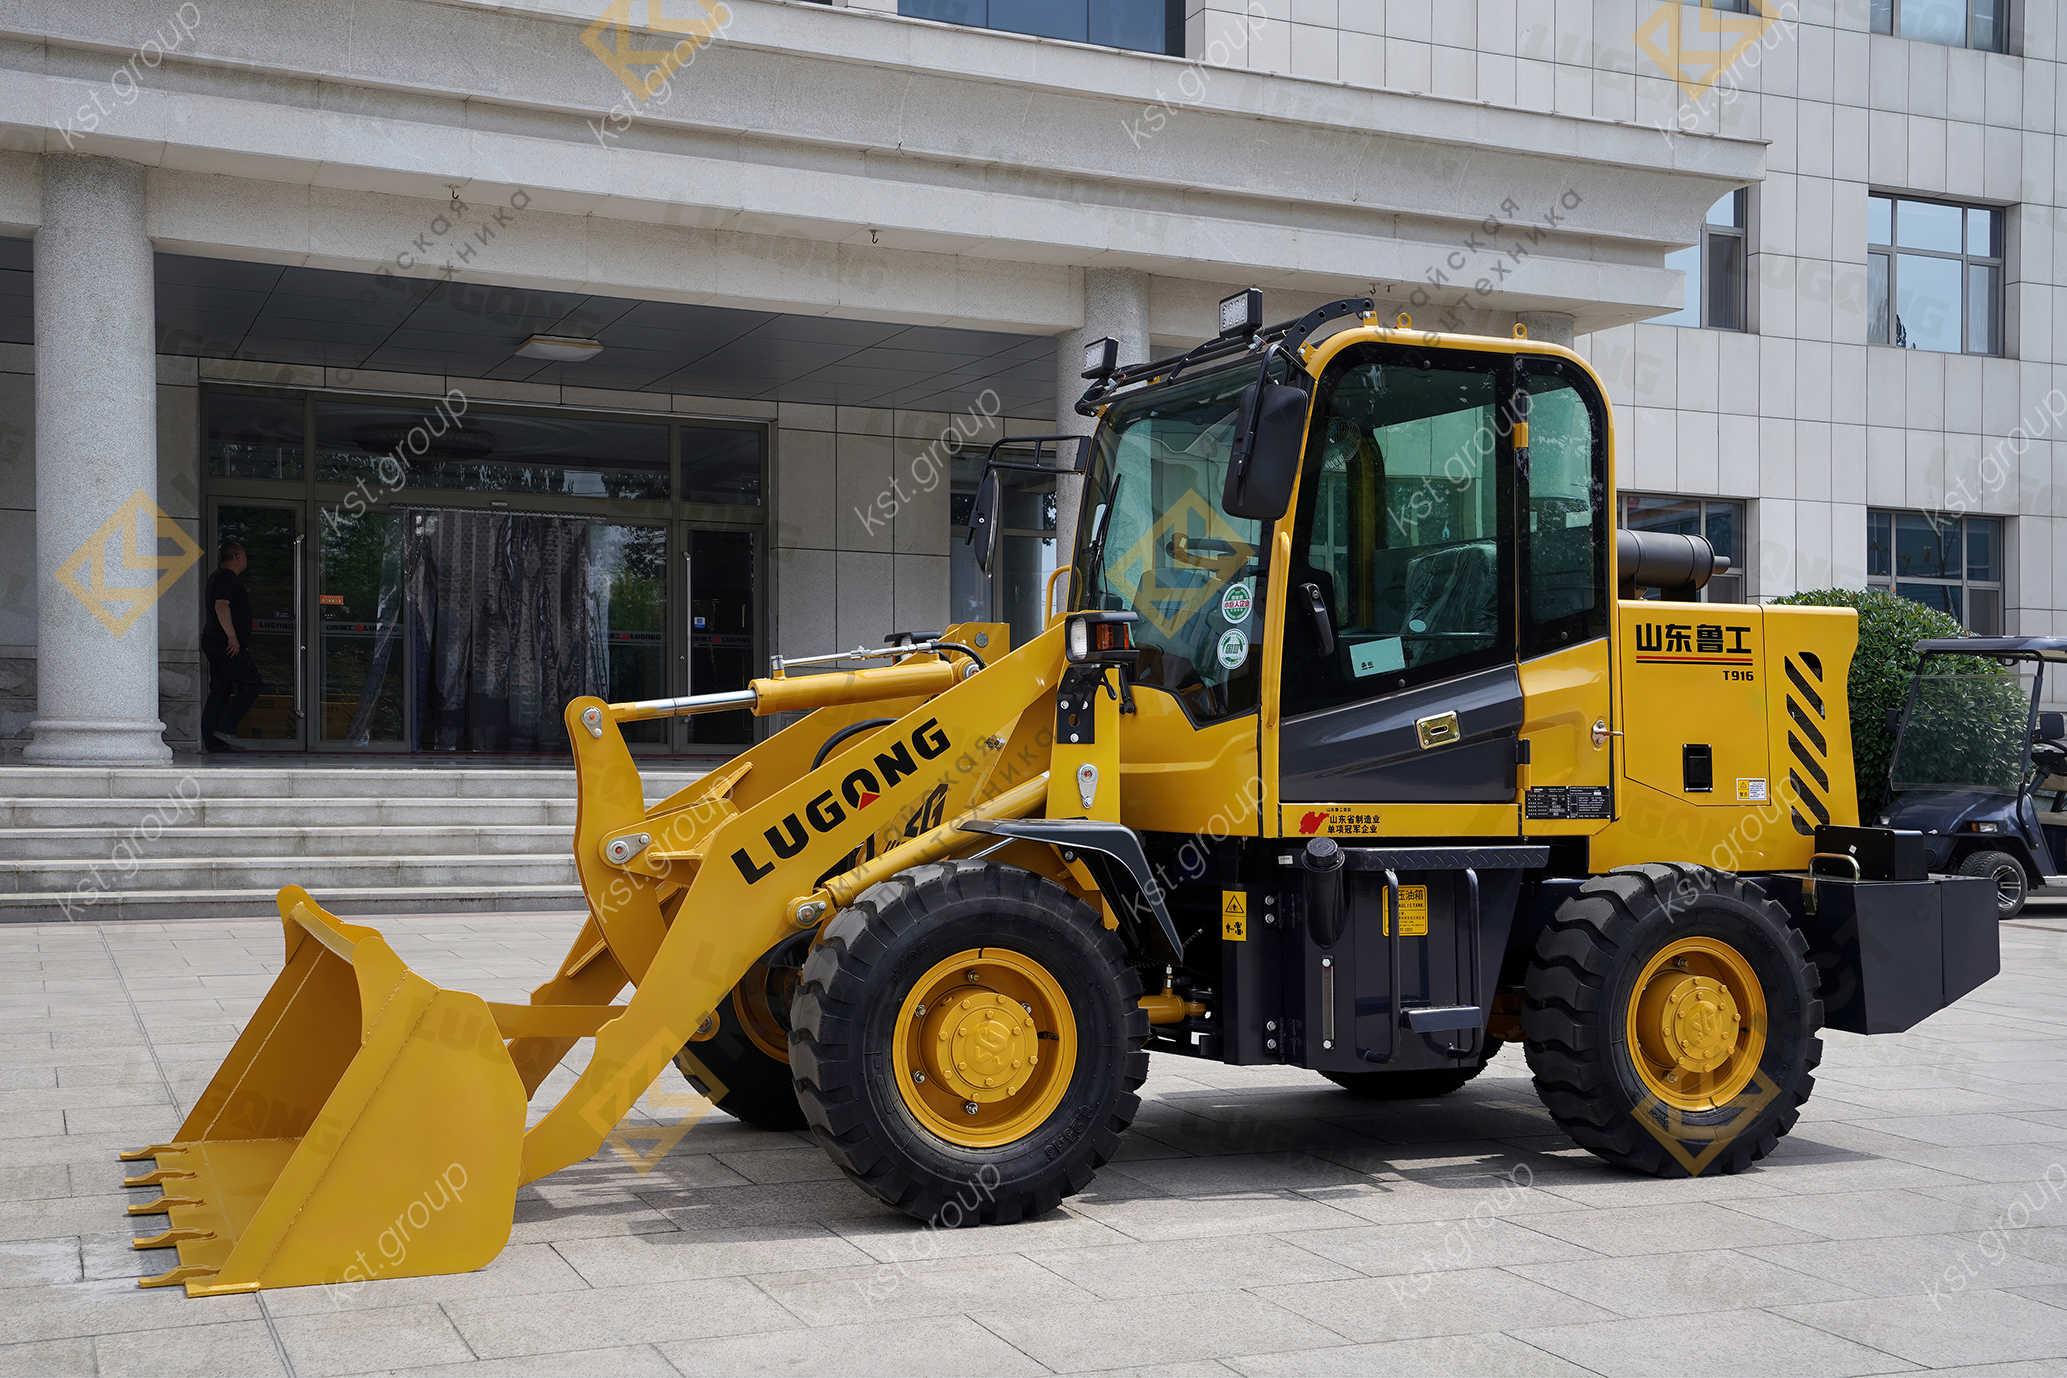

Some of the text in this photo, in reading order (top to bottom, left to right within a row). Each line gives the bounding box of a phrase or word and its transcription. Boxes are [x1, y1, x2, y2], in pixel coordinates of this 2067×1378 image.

[1636, 623, 1752, 654] 山东鲁工
[1722, 670, 1754, 682] T916
[730, 718, 952, 885] LUGONG
[1330, 815, 1380, 824] 山东省制造业
[1398, 889, 1424, 901] 压油箱
